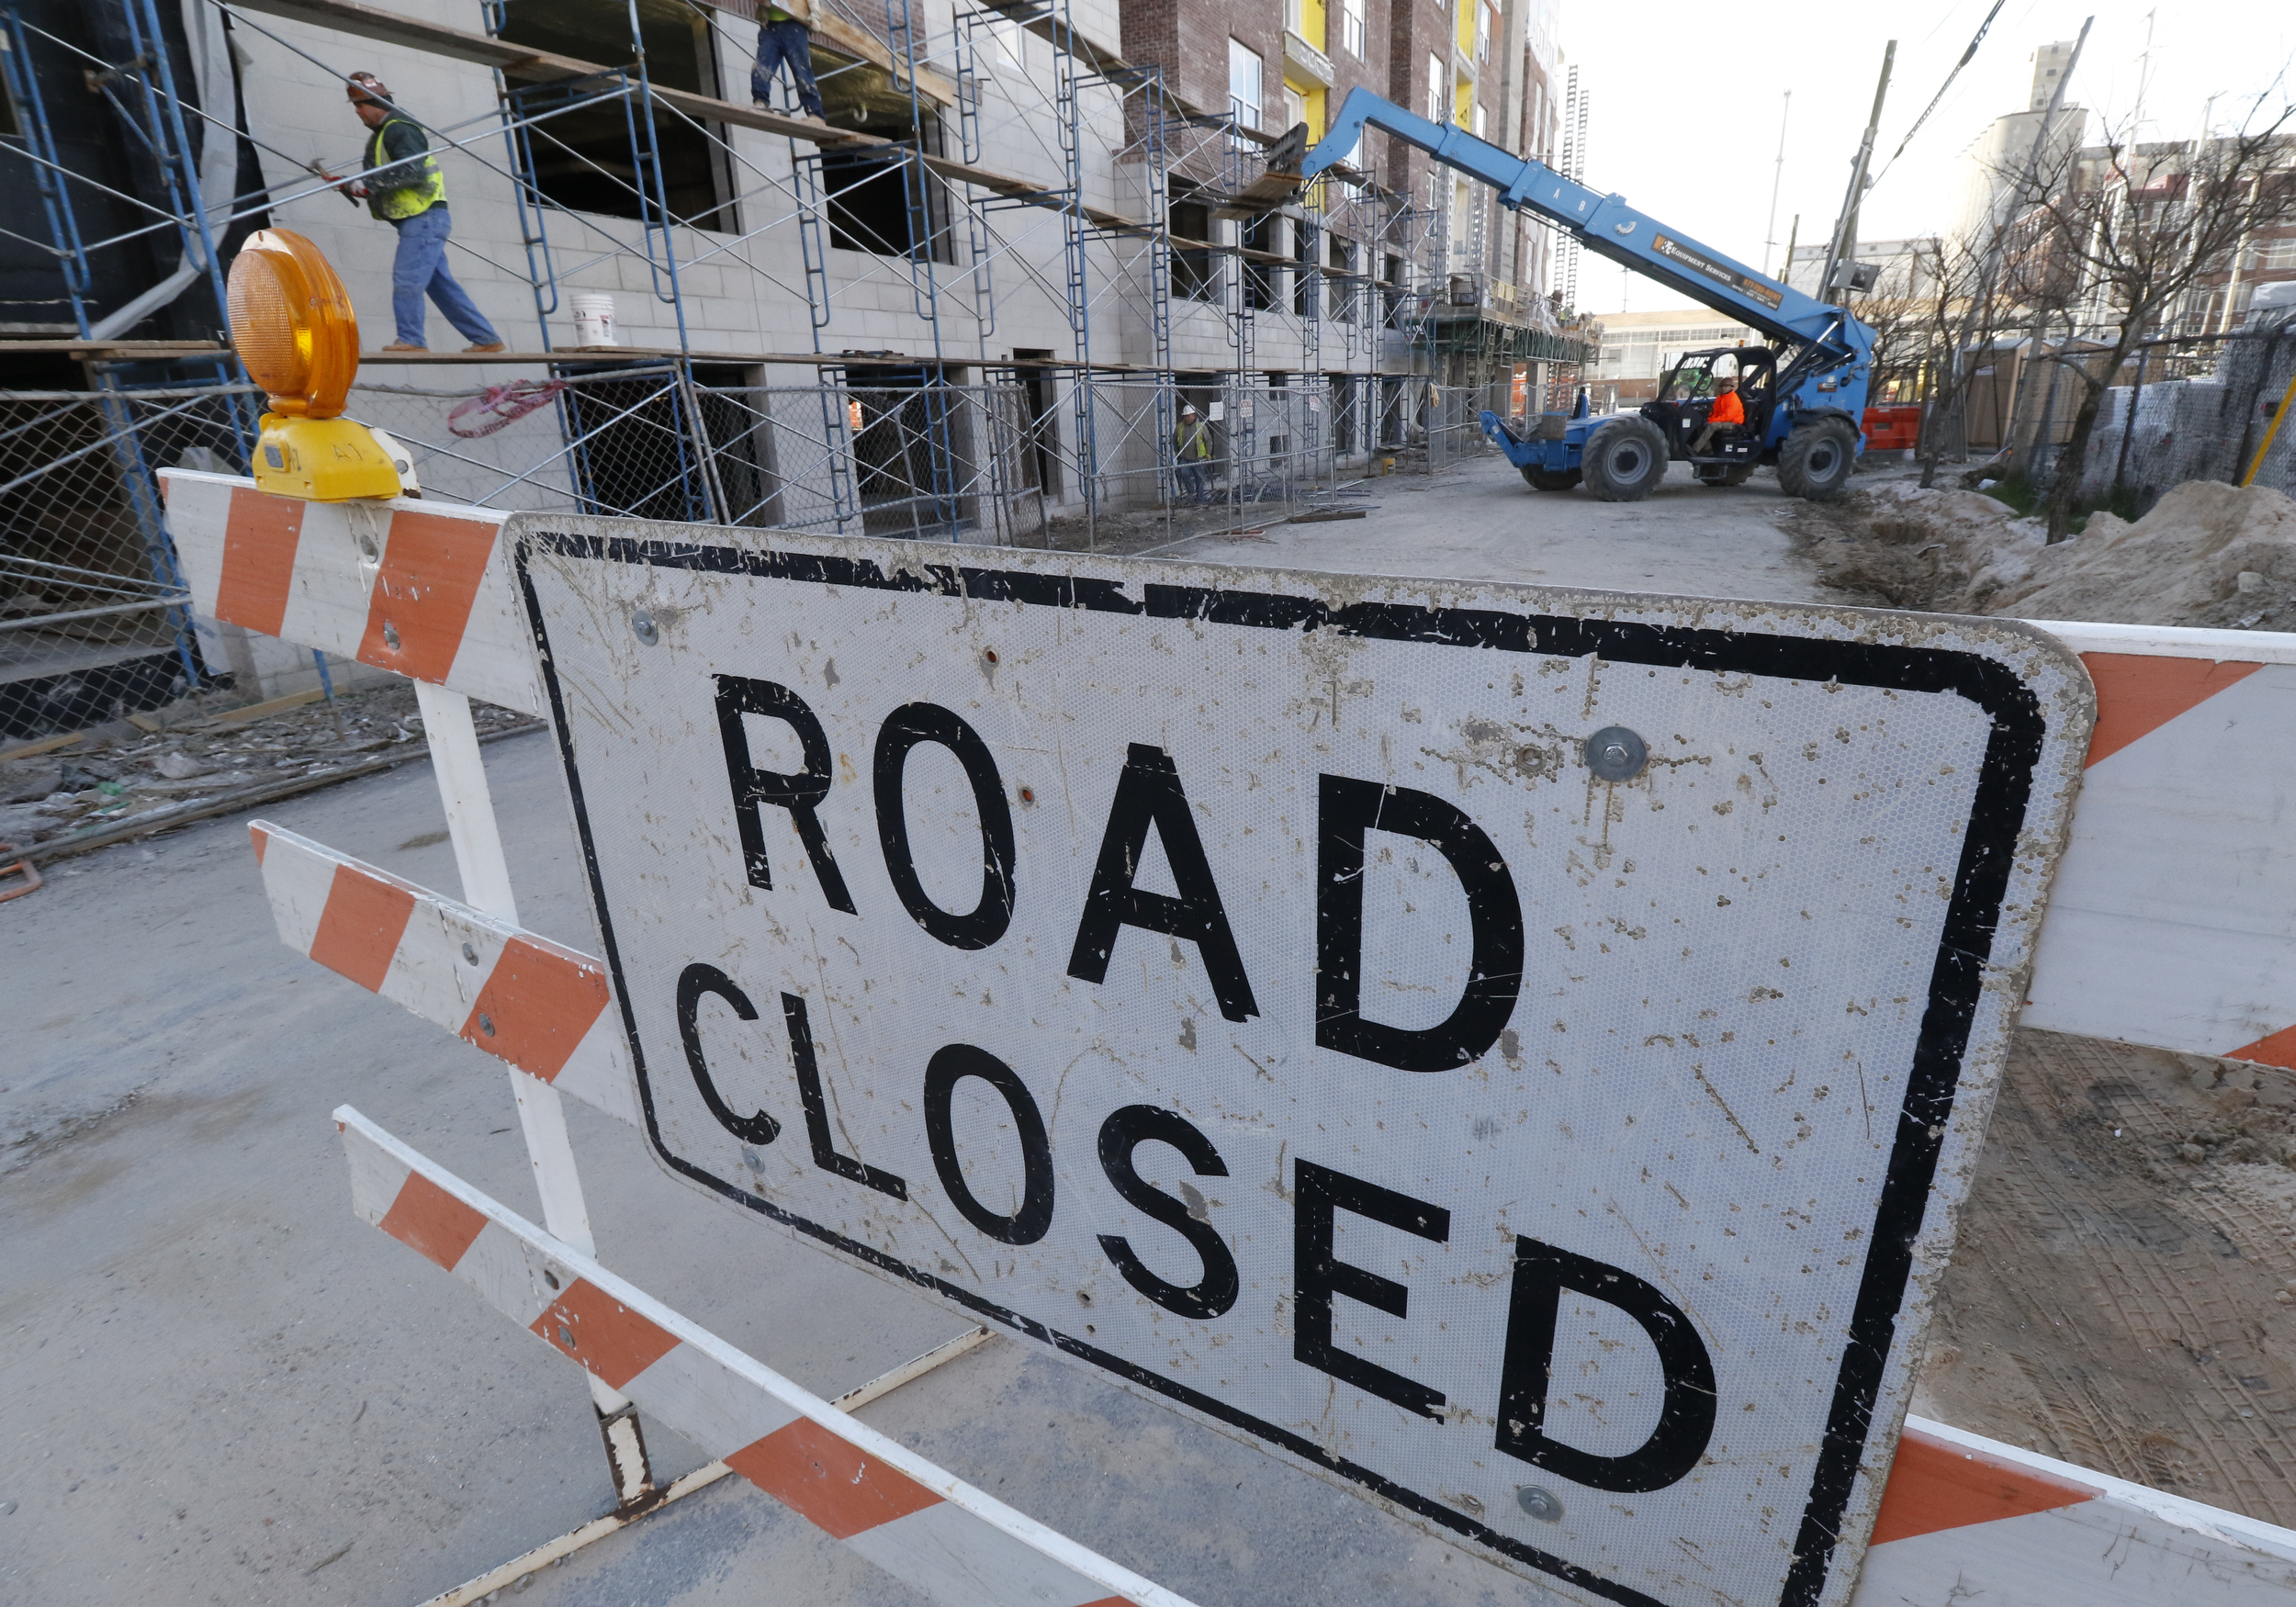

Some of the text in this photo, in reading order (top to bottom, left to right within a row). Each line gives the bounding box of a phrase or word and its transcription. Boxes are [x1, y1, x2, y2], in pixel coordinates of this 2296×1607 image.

[1553, 187, 1586, 211] A B
[712, 672, 1525, 1073] ROAD
[676, 961, 1717, 1494] CLOSED
